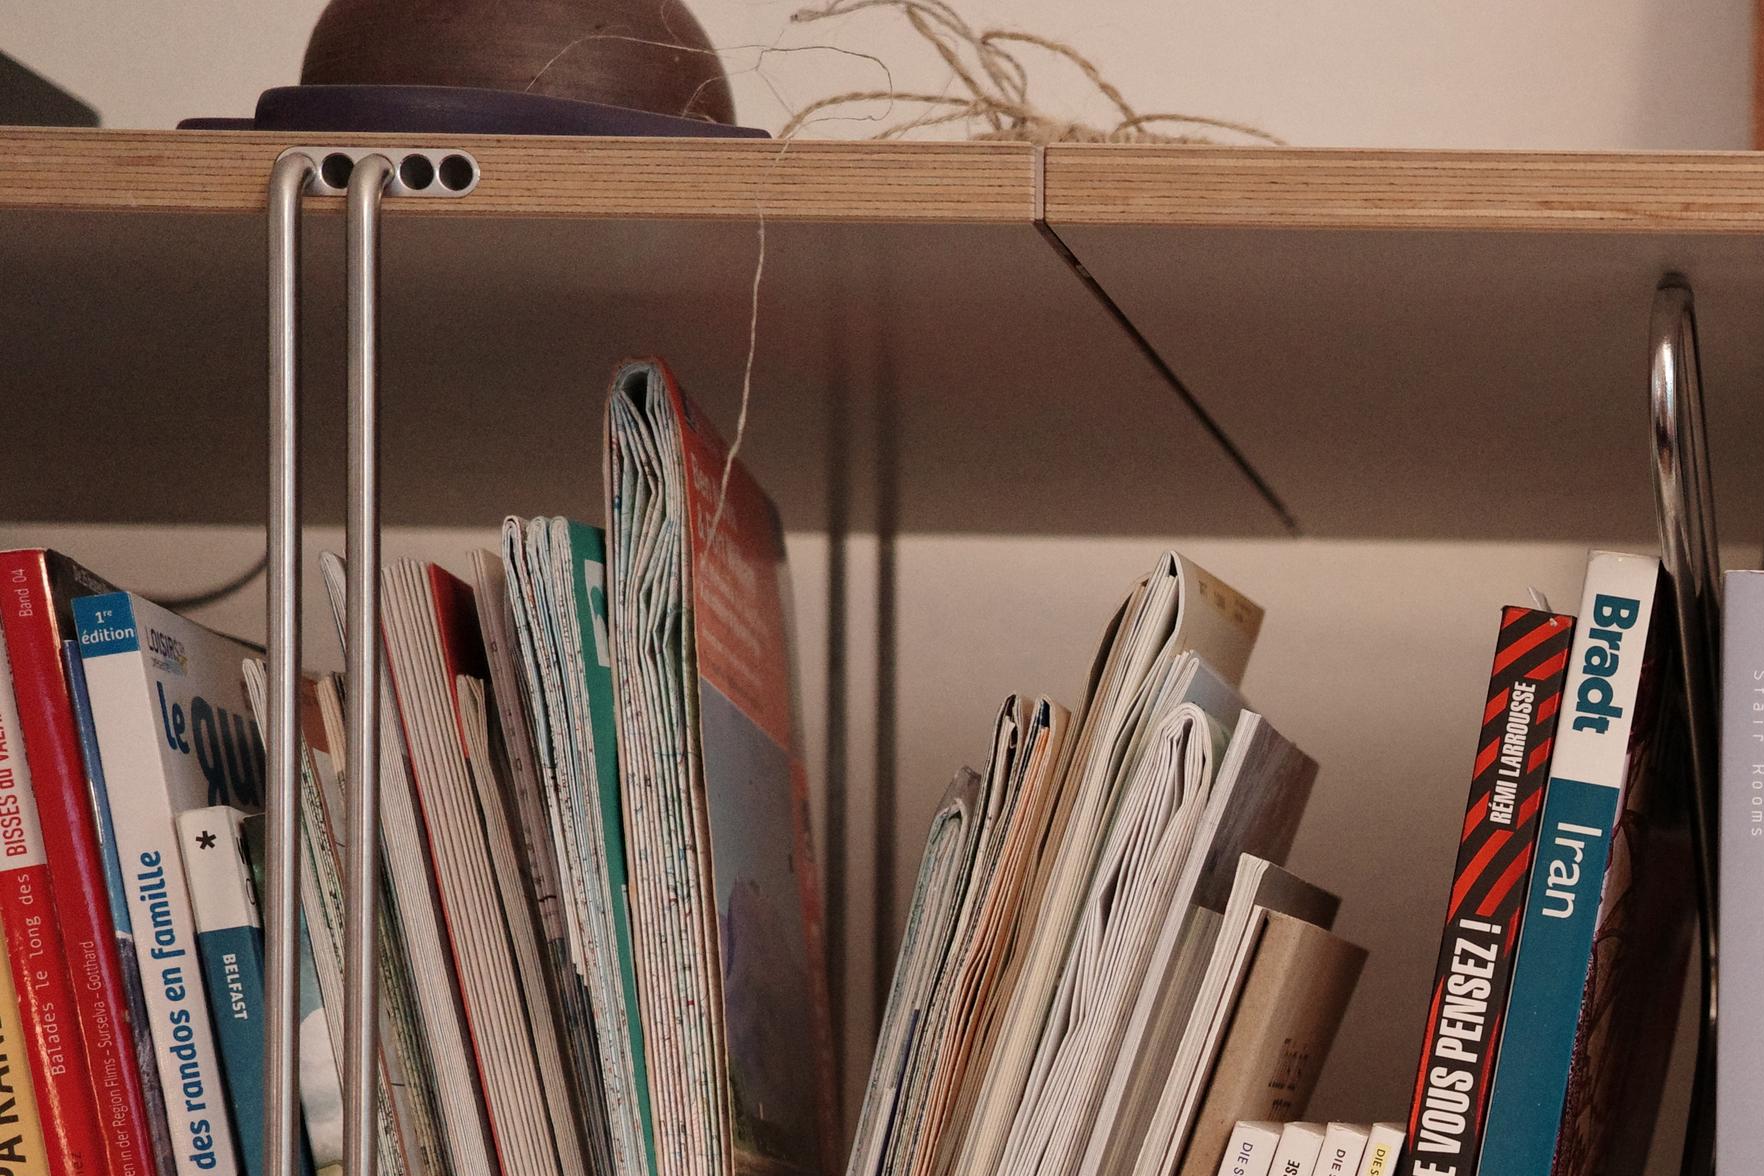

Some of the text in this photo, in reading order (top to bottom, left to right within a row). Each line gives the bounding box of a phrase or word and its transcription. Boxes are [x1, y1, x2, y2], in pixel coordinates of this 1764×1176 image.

[11, 568, 32, 616] Band 04
[81, 626, 135, 645] édition
[1572, 593, 1641, 735] Bradt
[1490, 681, 1536, 825] RÉMI LARROUSSE
[138, 851, 184, 959] famille
[1541, 821, 1603, 920] Iran
[17, 874, 66, 1076] Balades le long des
[161, 967, 185, 1001] en
[222, 953, 247, 1018] BELFAST
[1436, 939, 1499, 1063] PENSEZ
[169, 1009, 205, 1111] randos
[189, 1119, 216, 1169] des
[1418, 1067, 1474, 1155] VOUS
